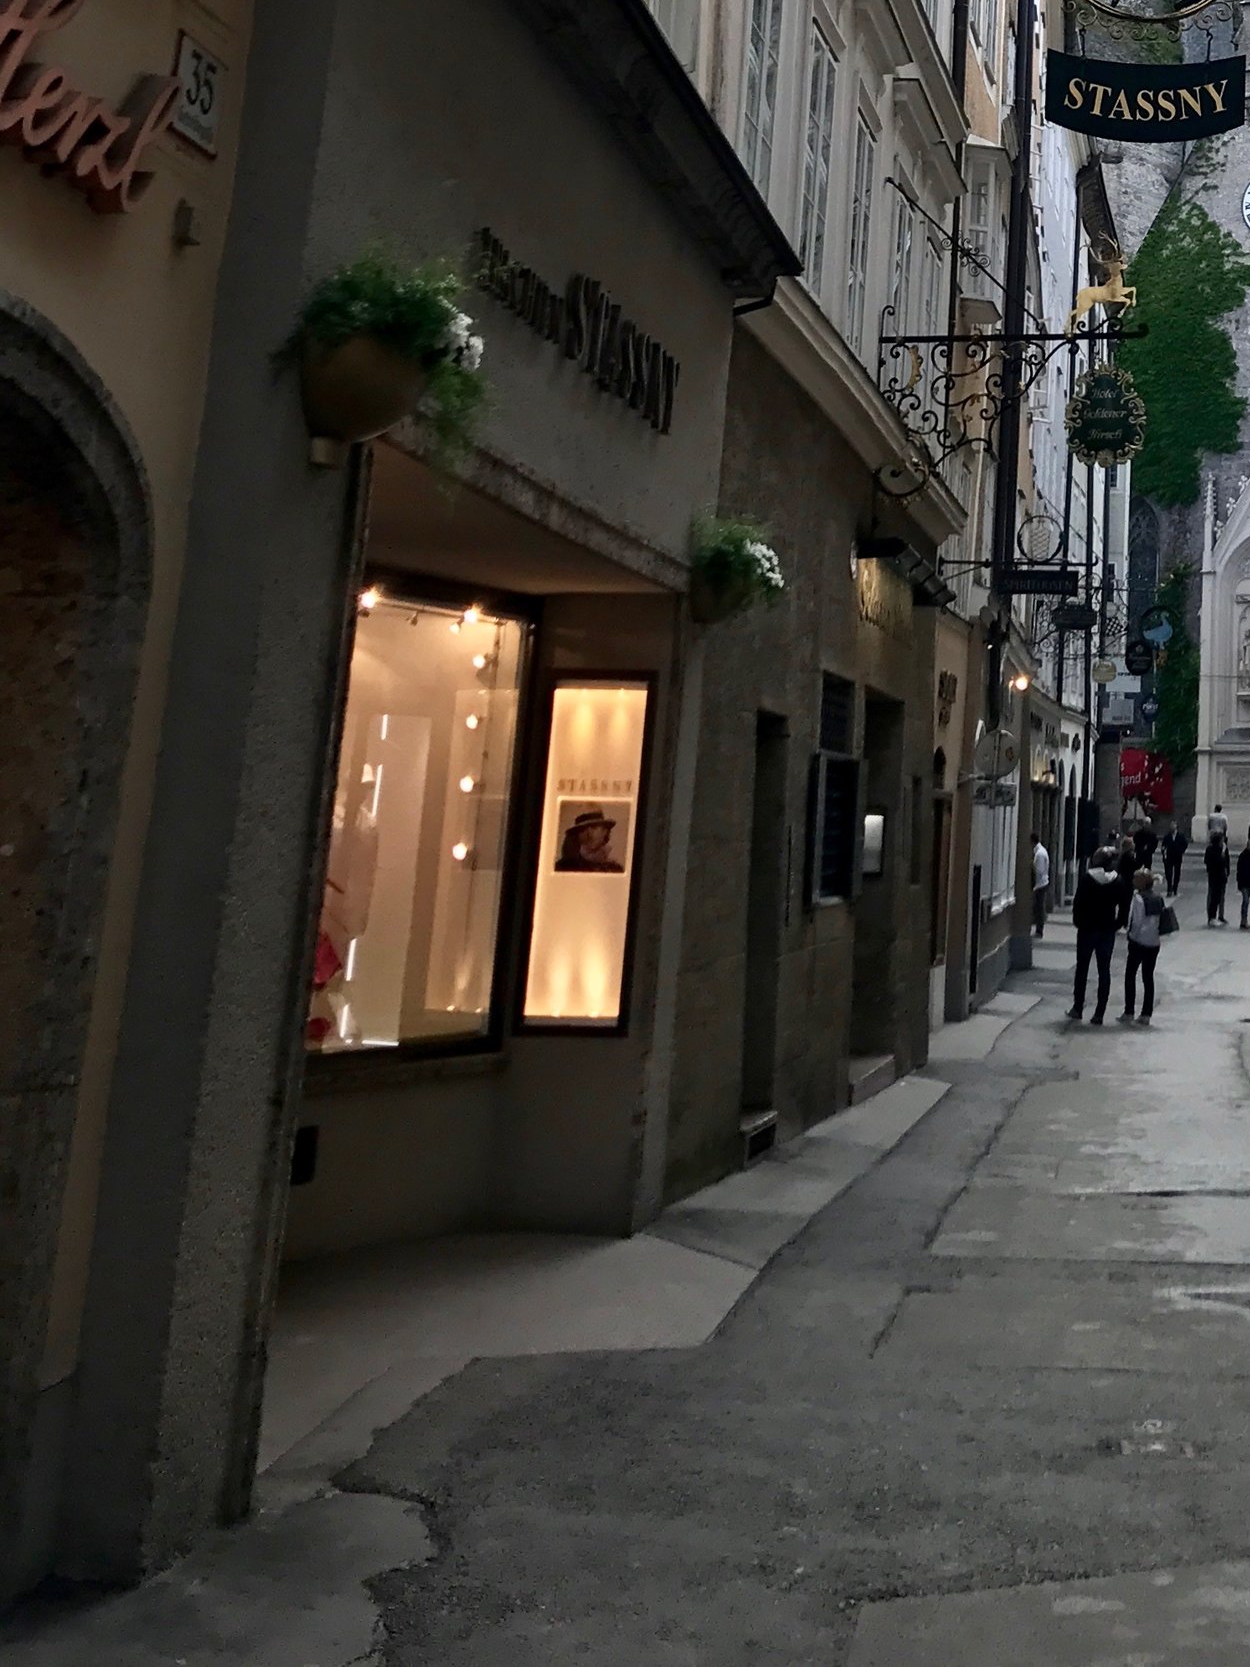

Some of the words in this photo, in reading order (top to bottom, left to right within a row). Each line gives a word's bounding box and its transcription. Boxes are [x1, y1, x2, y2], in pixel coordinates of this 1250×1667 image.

[185, 47, 217, 116] 35
[1063, 77, 1231, 122] STASSNY
[1091, 388, 1120, 399] Hotel
